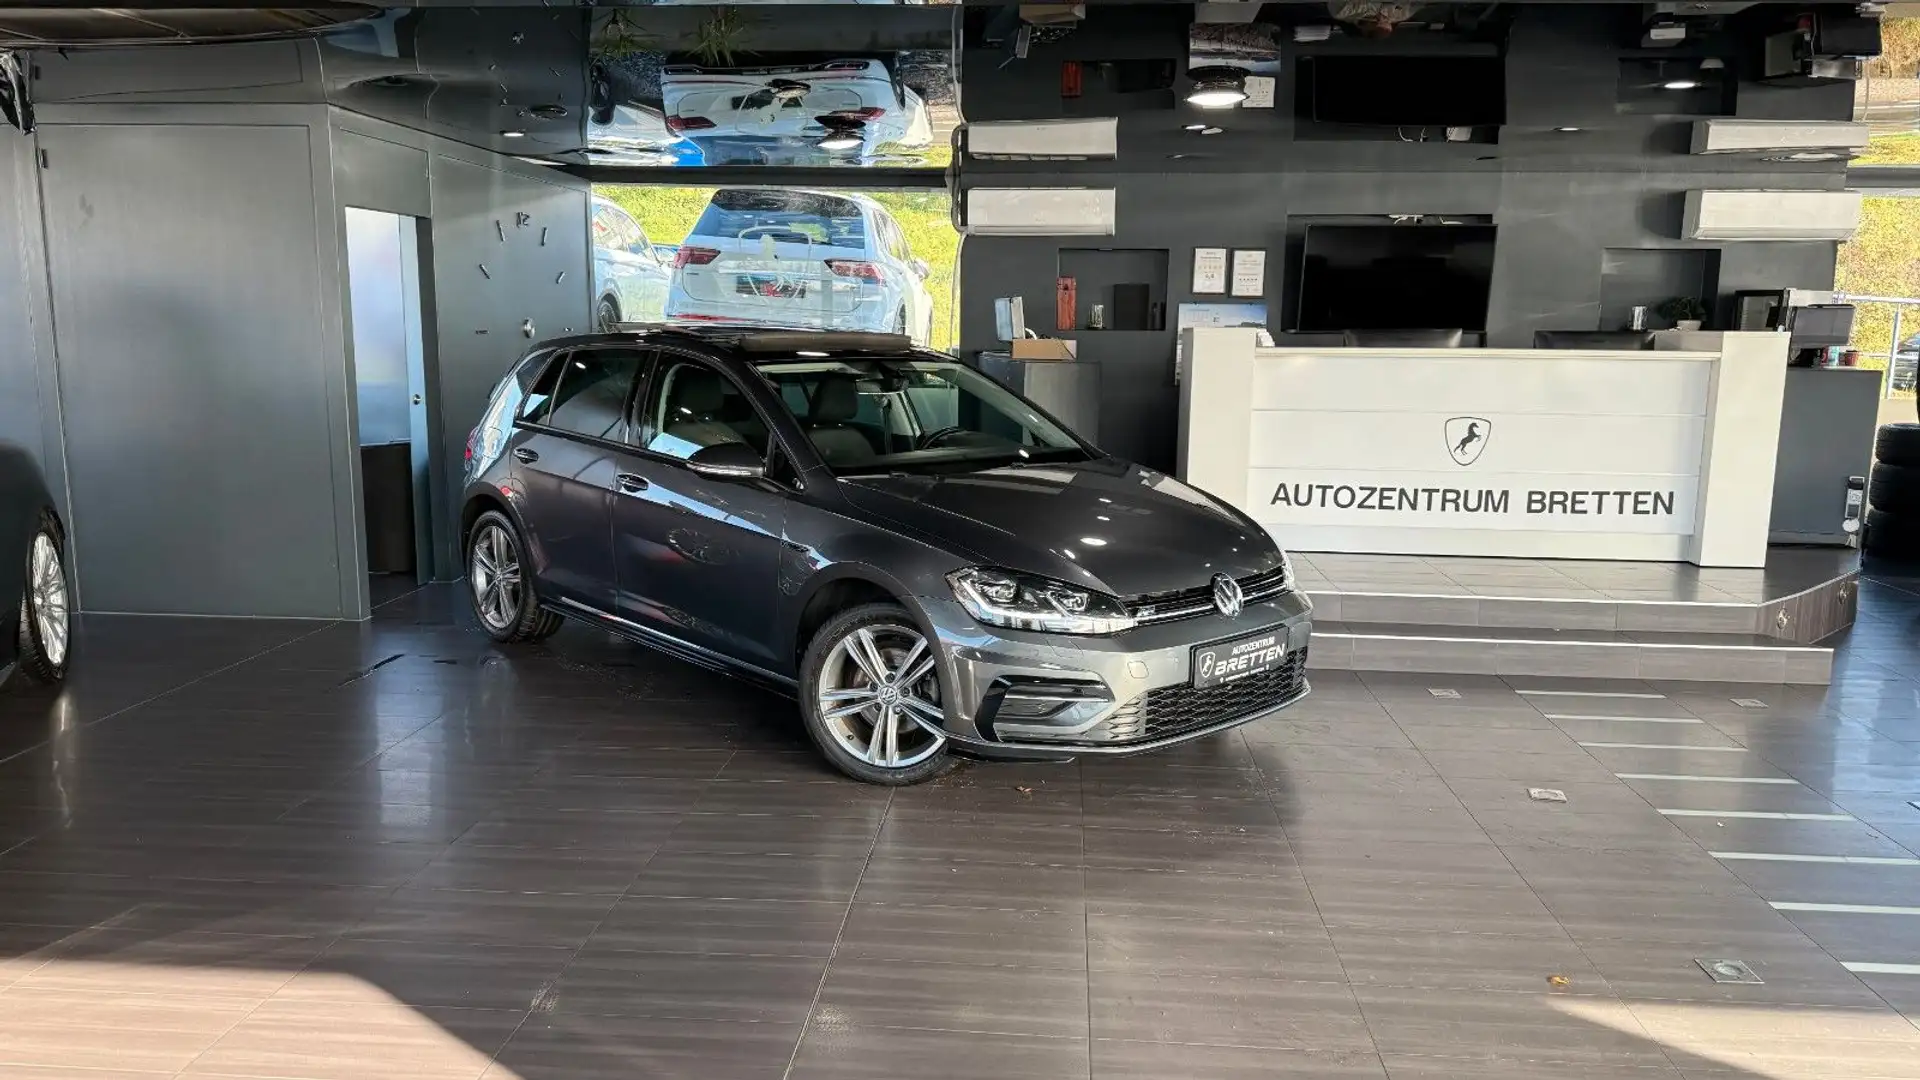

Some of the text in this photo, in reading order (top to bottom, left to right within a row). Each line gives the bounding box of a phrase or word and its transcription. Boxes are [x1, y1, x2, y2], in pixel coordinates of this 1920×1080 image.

[1270, 482, 1674, 515] AUTOZENTRUM BRETTEN
[1215, 643, 1285, 675] BRETTEN
[1232, 636, 1275, 655] AUTOZENTRUM
